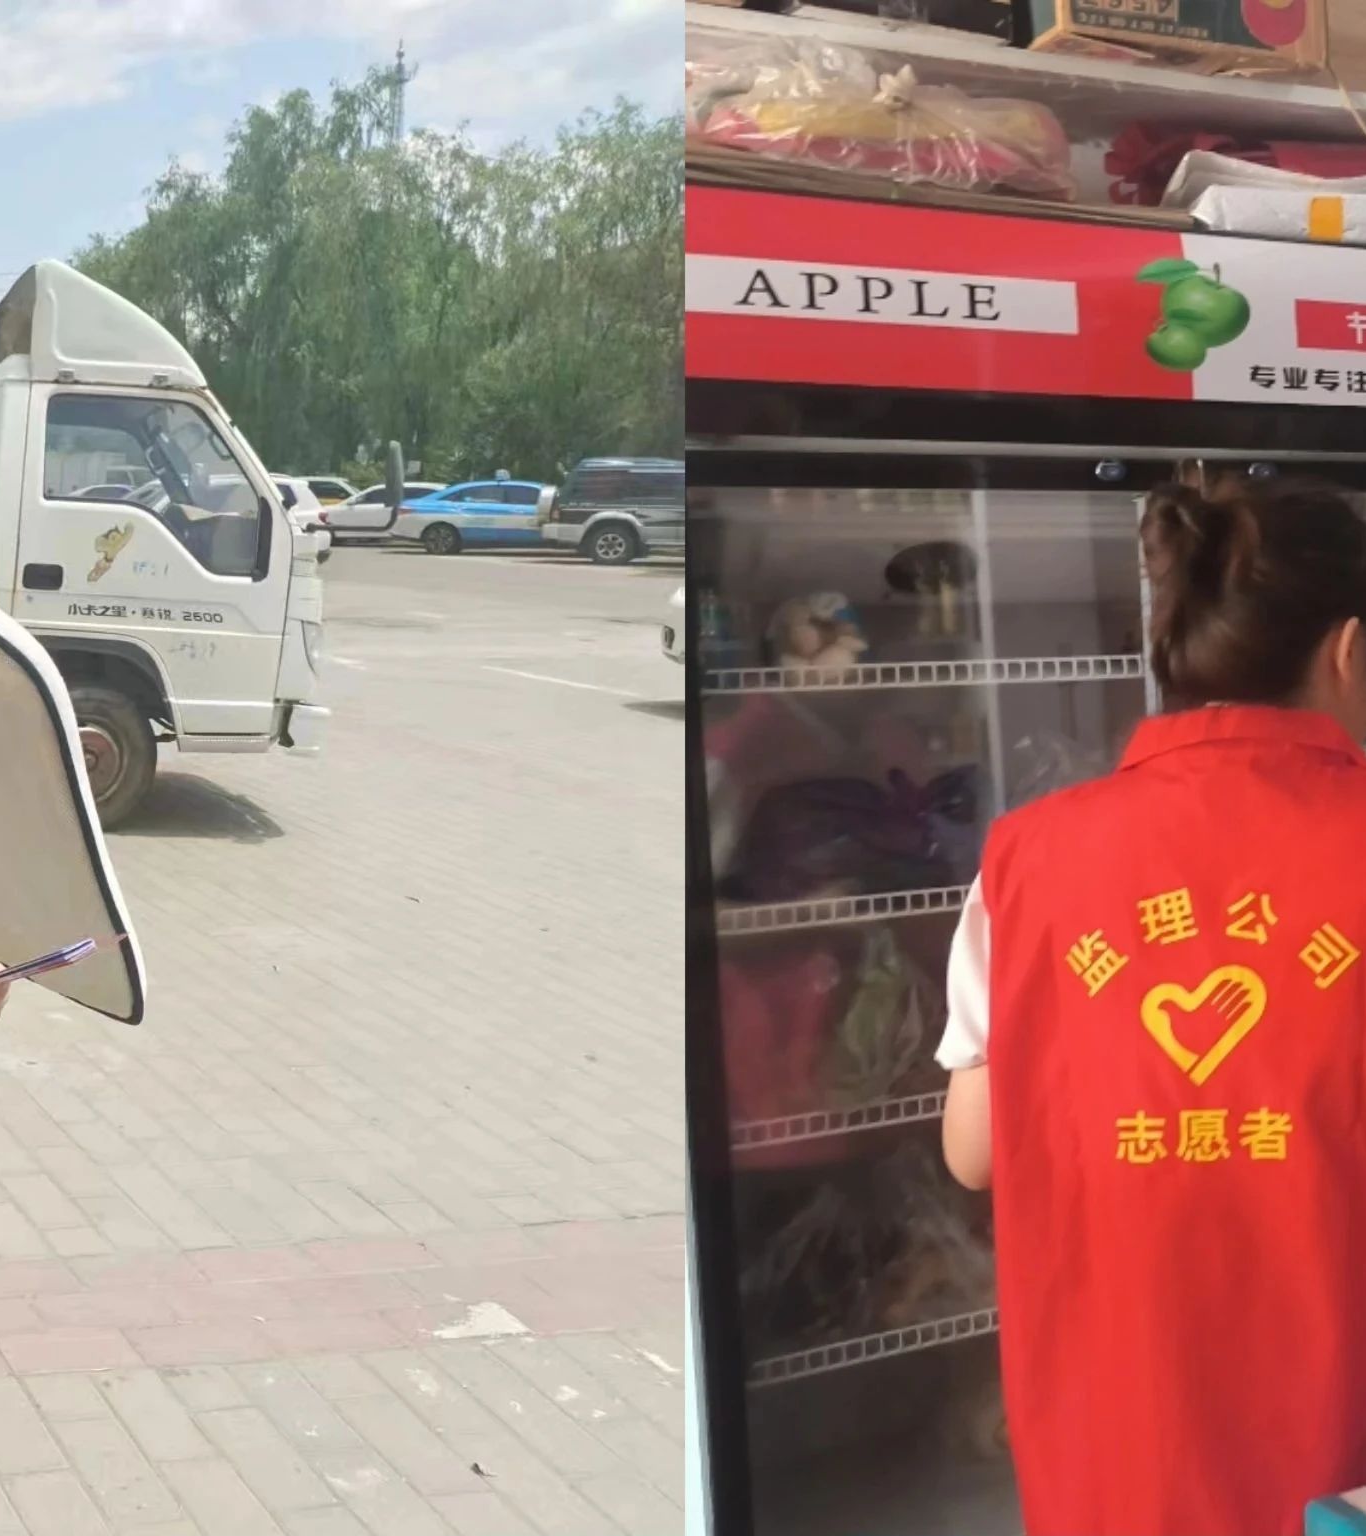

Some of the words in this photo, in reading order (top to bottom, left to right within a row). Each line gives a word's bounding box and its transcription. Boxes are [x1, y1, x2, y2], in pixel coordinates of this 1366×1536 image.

[734, 268, 1001, 321] APPLE
[1064, 886, 1361, 998] 监理公司
[1114, 1105, 1294, 1164] 志愿者
